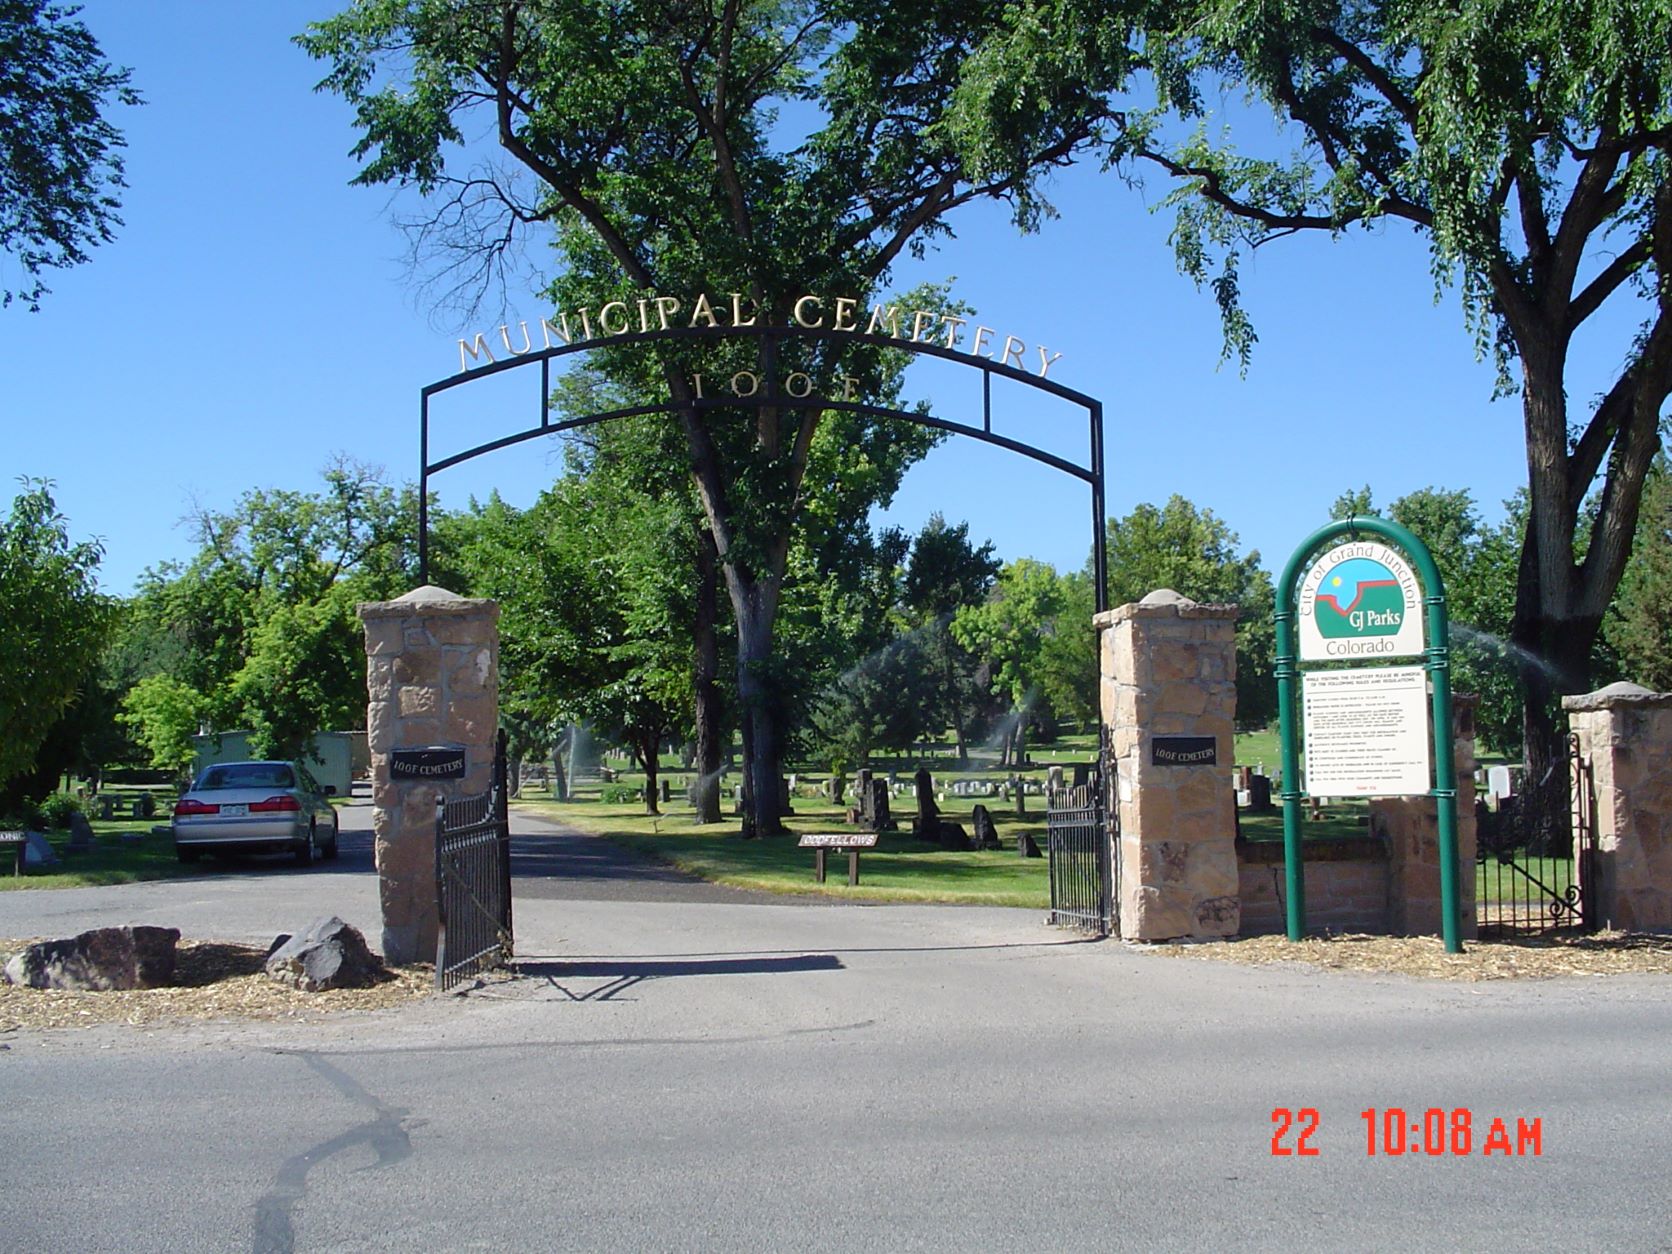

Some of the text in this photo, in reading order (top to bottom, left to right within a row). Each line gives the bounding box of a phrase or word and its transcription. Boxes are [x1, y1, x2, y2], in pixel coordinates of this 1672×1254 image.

[457, 293, 1063, 379] MUNICIPAL CEMETERY
[1300, 545, 1416, 616] City of Grand Junction
[1349, 608, 1401, 632] GJ Parks
[1326, 638, 1395, 656] Colorado
[419, 759, 463, 775] CEMETERY
[803, 834, 875, 845] ODDFELLOWS
